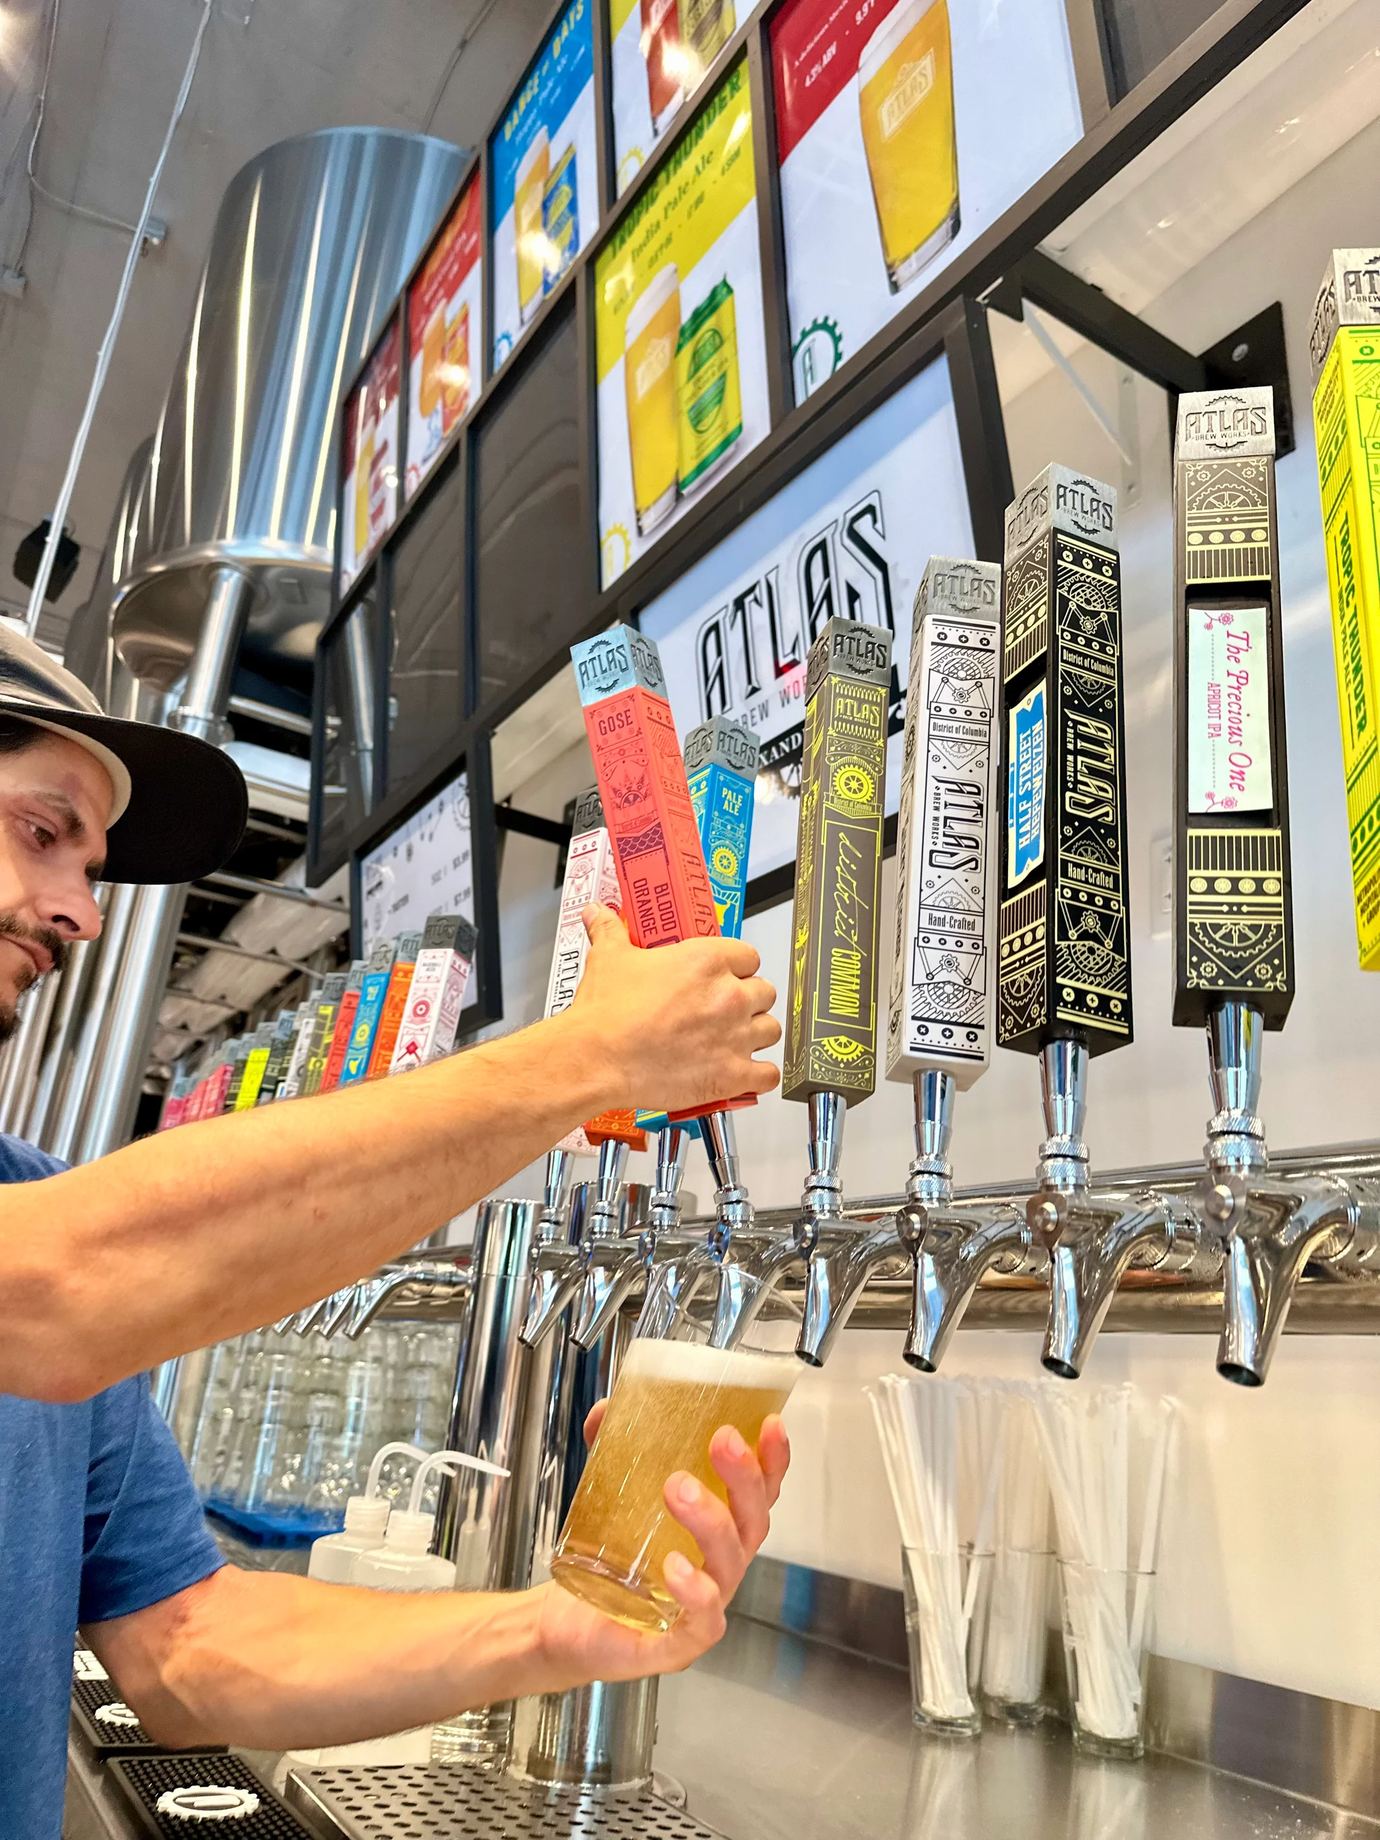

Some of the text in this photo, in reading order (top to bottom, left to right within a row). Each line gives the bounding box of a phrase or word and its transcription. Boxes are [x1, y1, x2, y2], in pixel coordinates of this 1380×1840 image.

[1185, 406, 1268, 442] ATLAS
[1194, 431, 1247, 441] BREW WORKS
[1056, 483, 1114, 532] ATLAS
[695, 488, 896, 722] ATLAS
[932, 572, 996, 606] ATLAS
[1339, 510, 1368, 742] TROPIC THUNDER
[578, 643, 630, 690] ATLAS
[833, 633, 887, 669] ATLAS
[1062, 648, 1083, 665] District
[1091, 657, 1115, 678] Columbia
[598, 709, 634, 737] GOSE
[834, 697, 880, 727] ATLAS
[932, 721, 988, 739] District of Columbia
[1207, 681, 1222, 740] APRICOT IPA
[1226, 630, 1253, 793] The Precious One
[717, 730, 757, 769] ATLAS
[1064, 708, 1116, 826] ATLAS
[1065, 727, 1075, 782] BREW WORKS
[721, 787, 743, 807] PALE
[1018, 727, 1032, 851] HALF STREET
[1030, 718, 1045, 845] HEFEWEIZEN
[722, 801, 740, 817] ALE
[929, 775, 984, 874] ATLAS
[931, 791, 941, 840] BREW WORKS
[632, 877, 658, 939] ORANGE
[653, 882, 677, 932] BLOOD
[680, 851, 717, 937] ATLAS
[928, 912, 976, 932] Hand-Crafted
[828, 947, 861, 1018] COMMON
